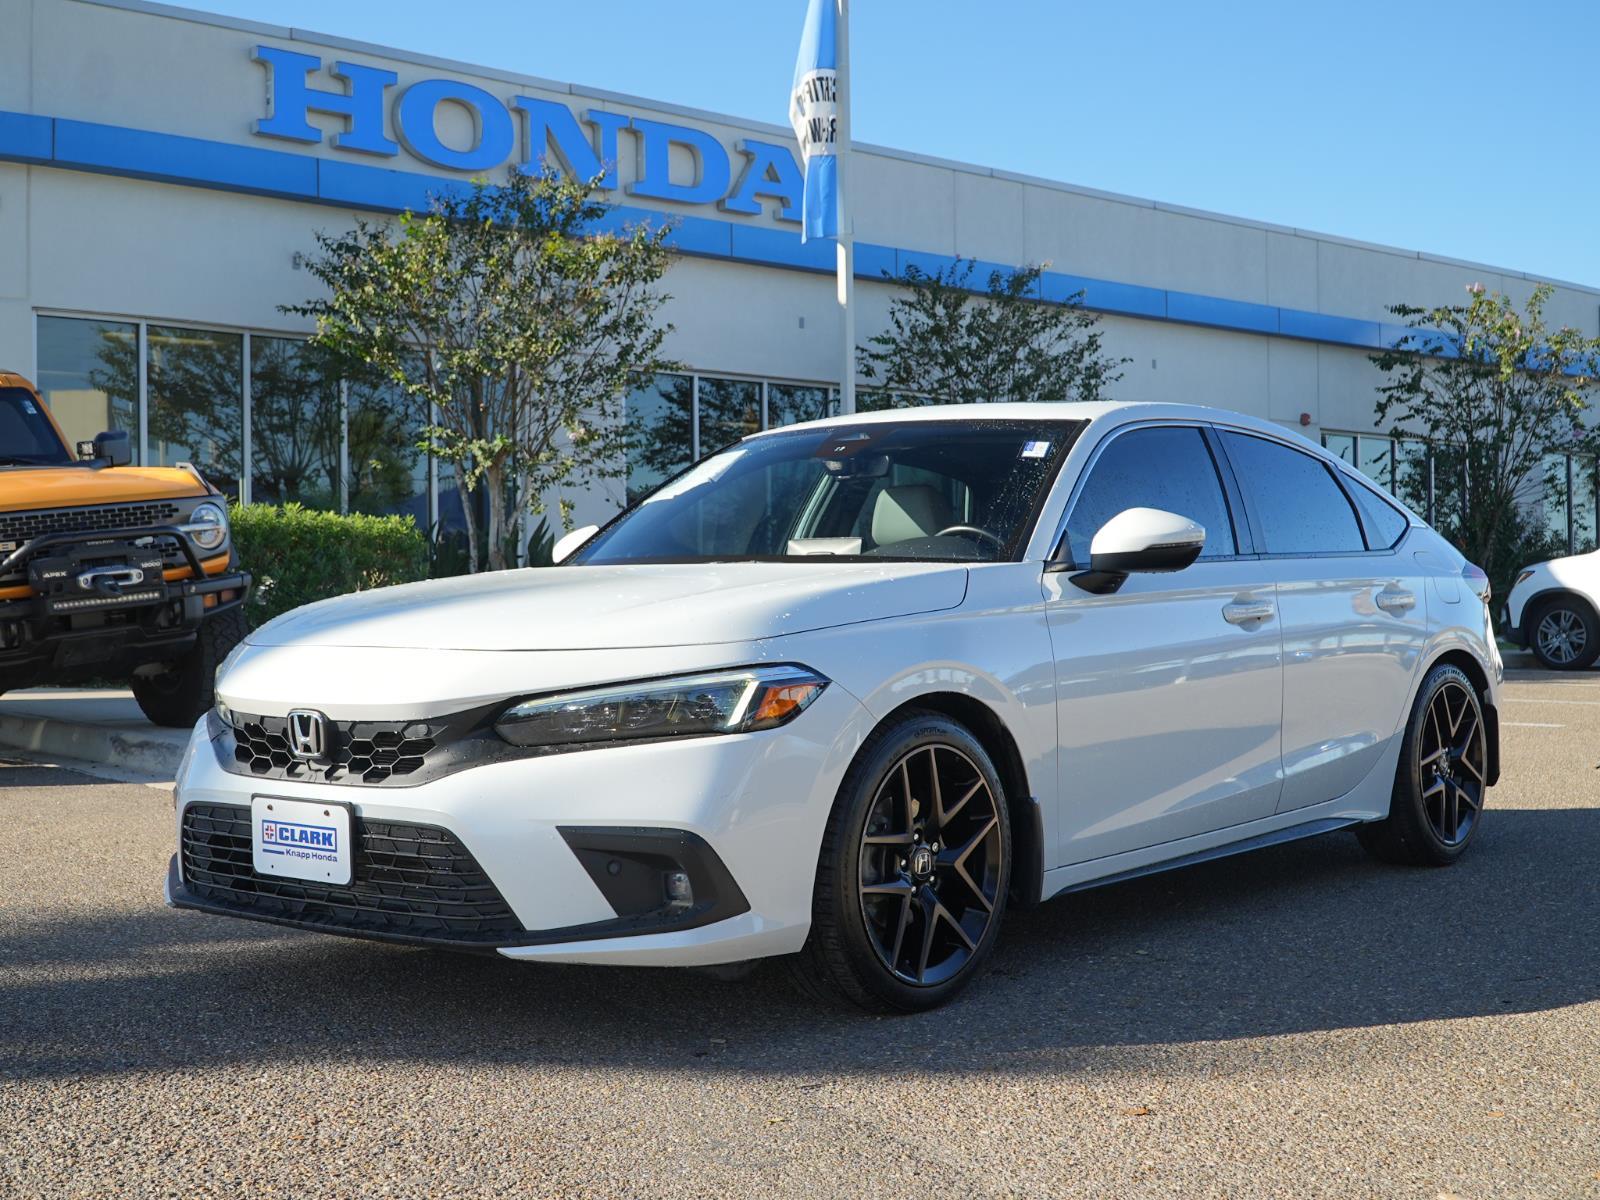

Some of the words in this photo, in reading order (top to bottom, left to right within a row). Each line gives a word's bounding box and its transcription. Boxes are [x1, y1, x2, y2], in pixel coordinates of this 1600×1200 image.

[250, 45, 804, 222] HONDA
[278, 827, 334, 847] CLARK
[285, 848, 311, 860] Knapp
[311, 852, 338, 863] Honda
